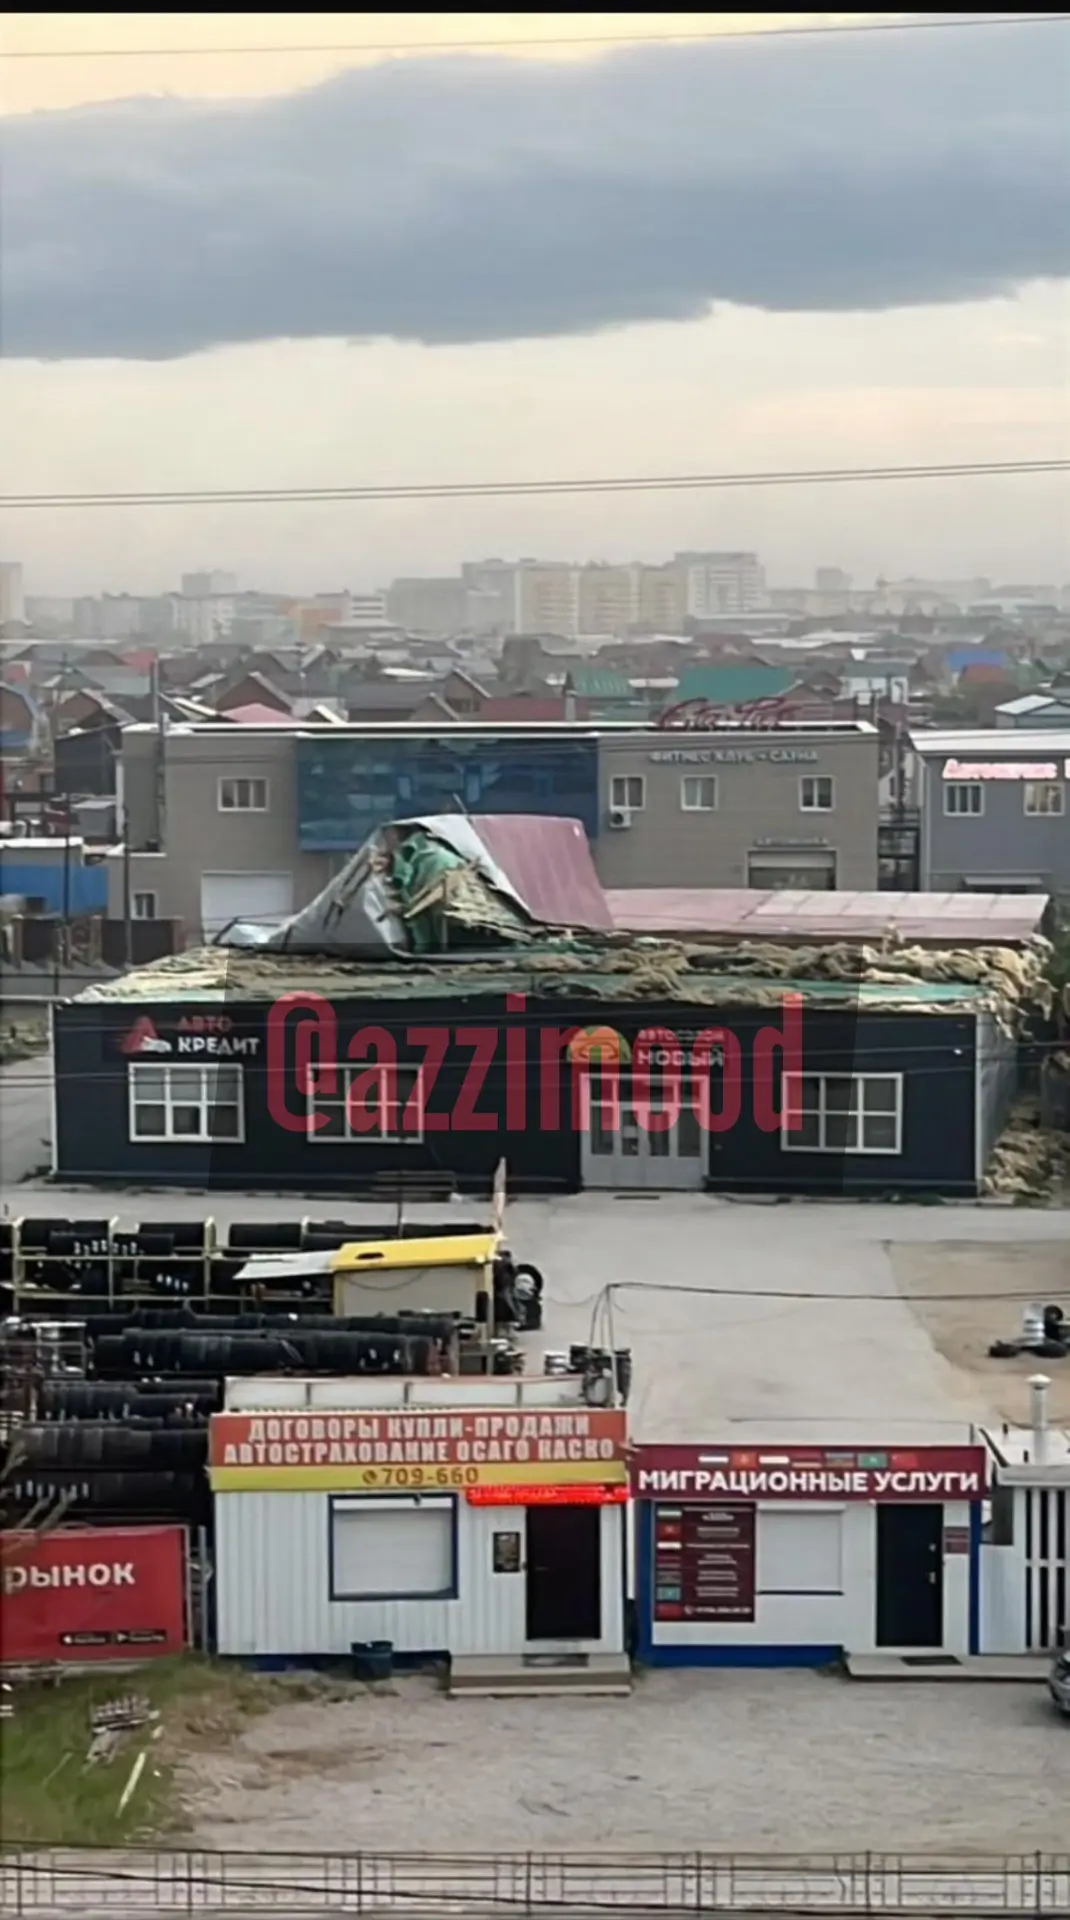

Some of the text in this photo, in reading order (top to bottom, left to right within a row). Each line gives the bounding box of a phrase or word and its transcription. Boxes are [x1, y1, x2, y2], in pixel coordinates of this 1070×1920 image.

[176, 1015, 232, 1033] АВТО
[178, 1036, 260, 1054] КРЕДИТ
[637, 1047, 725, 1067] НОВЫЙ
[248, 1415, 591, 1443] ДОГОВОРЫ КУПЛИ-ПРОДАЖИ
[224, 1437, 614, 1465] АВТОСТРАХОВАНИЕ ОСАГО КАСКО
[382, 1467, 479, 1485] 709-660
[638, 1470, 868, 1495] МИГРАЦИОННЫЕ
[875, 1471, 978, 1493] УСЛУГИ
